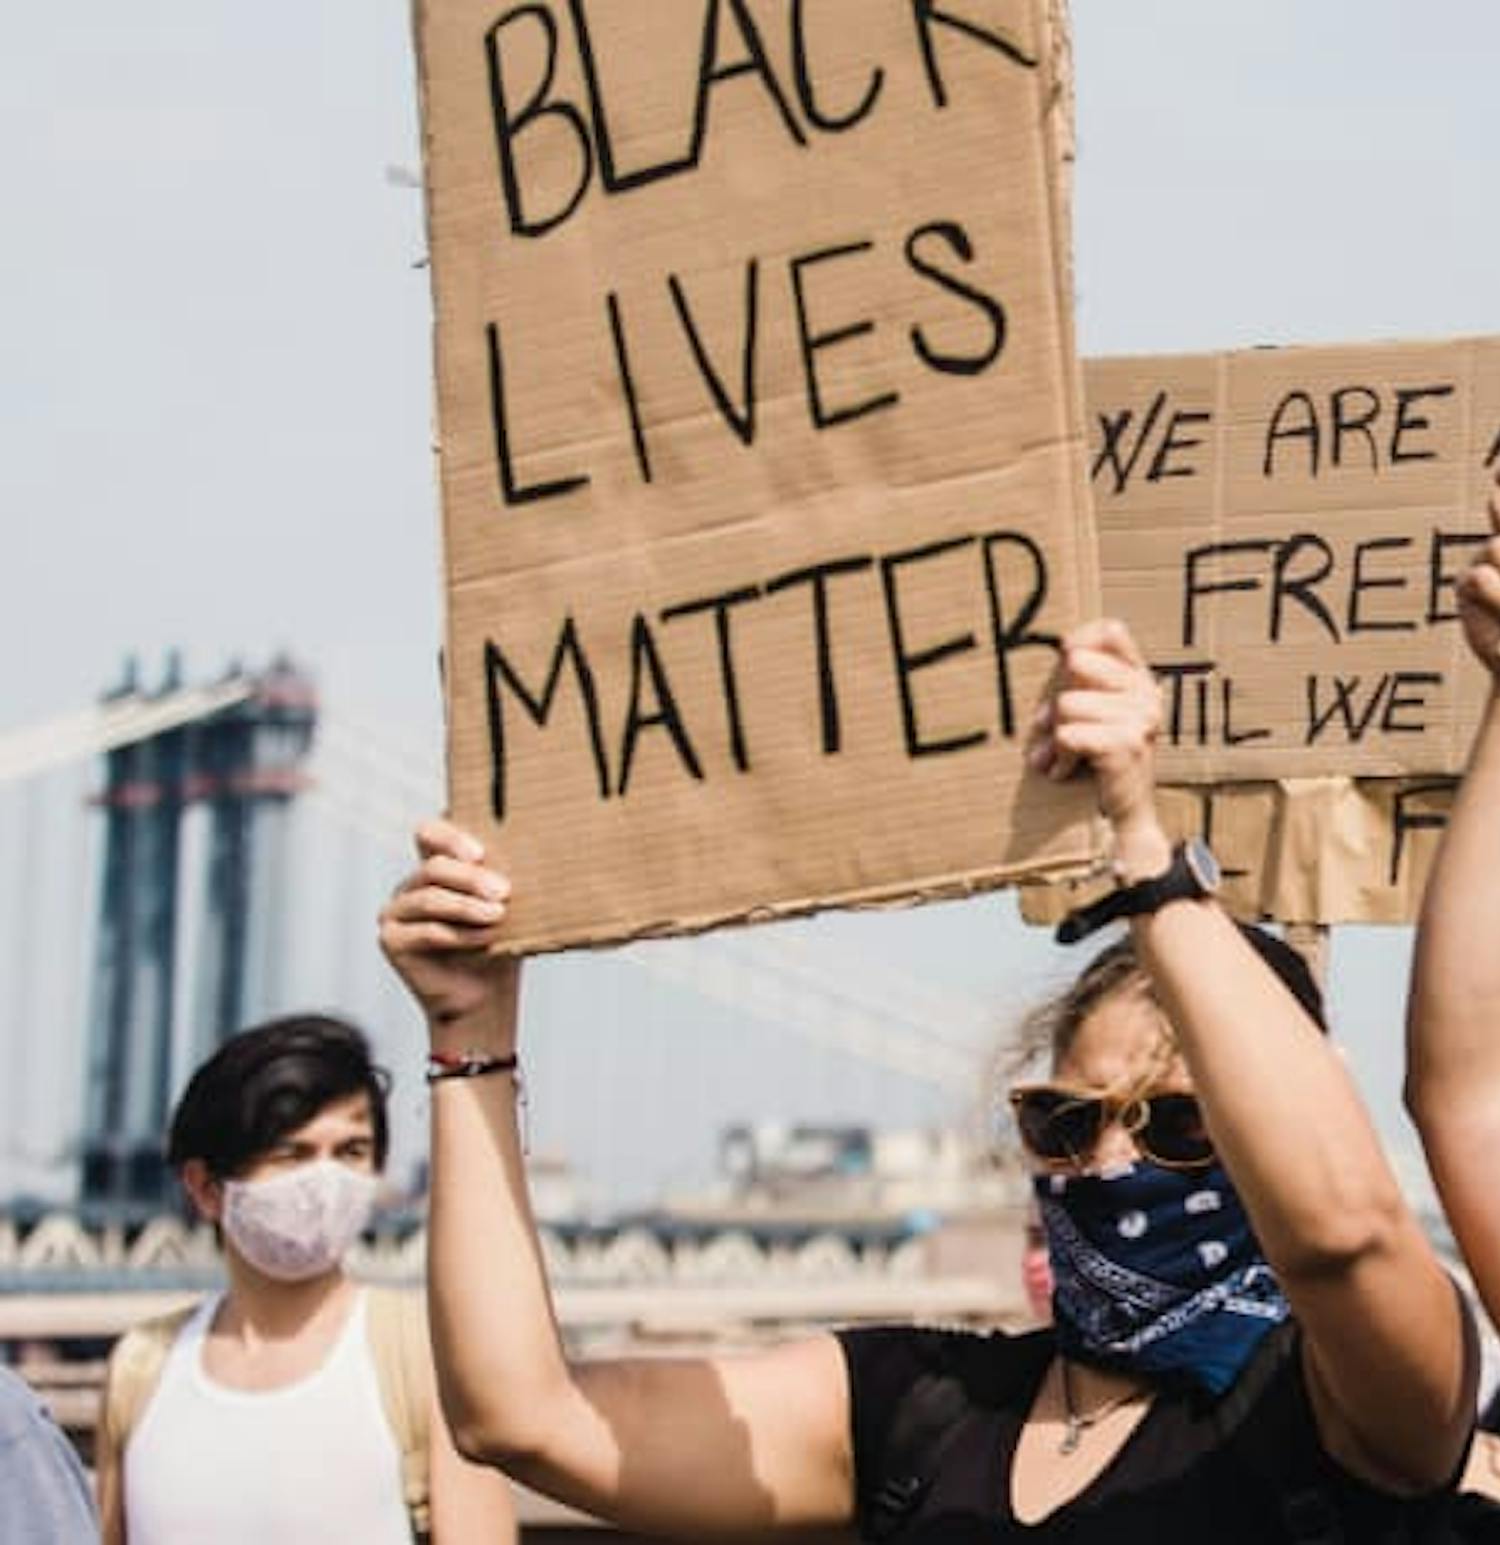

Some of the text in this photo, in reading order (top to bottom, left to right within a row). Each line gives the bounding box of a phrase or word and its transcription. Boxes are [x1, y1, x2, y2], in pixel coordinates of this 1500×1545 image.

[486, 221, 1007, 501] LIVES
[1091, 390, 1211, 494] WE
[1263, 384, 1455, 478] ARE
[484, 531, 1067, 822] MATTER
[1148, 662, 1445, 746] TIL WE
